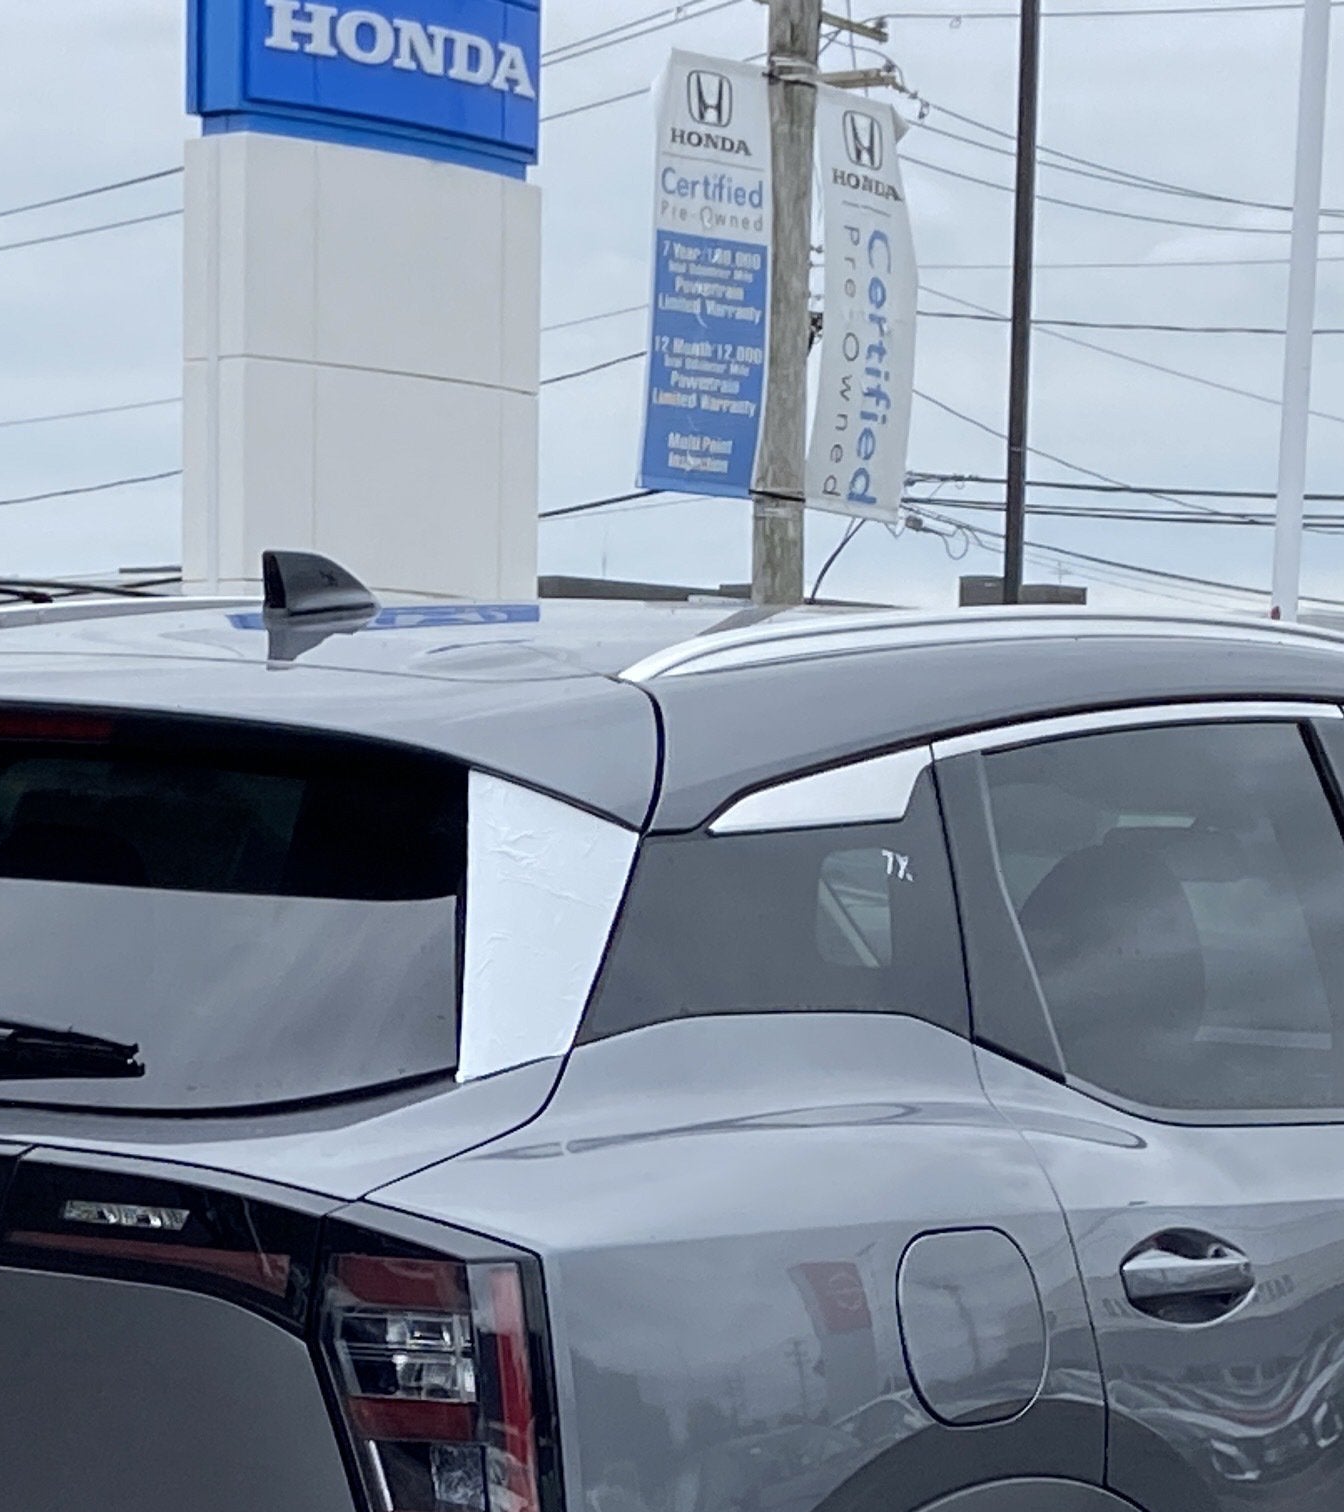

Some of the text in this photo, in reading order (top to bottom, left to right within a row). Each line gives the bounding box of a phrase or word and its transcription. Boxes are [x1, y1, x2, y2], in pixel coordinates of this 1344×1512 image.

[263, 0, 536, 100] HONDA
[670, 127, 752, 156] HONDA
[661, 166, 763, 209] Certified
[832, 168, 905, 204] HONDA
[660, 199, 763, 232] Pre-Owned
[822, 225, 860, 497] Pre-Owned
[847, 230, 891, 505] Certified
